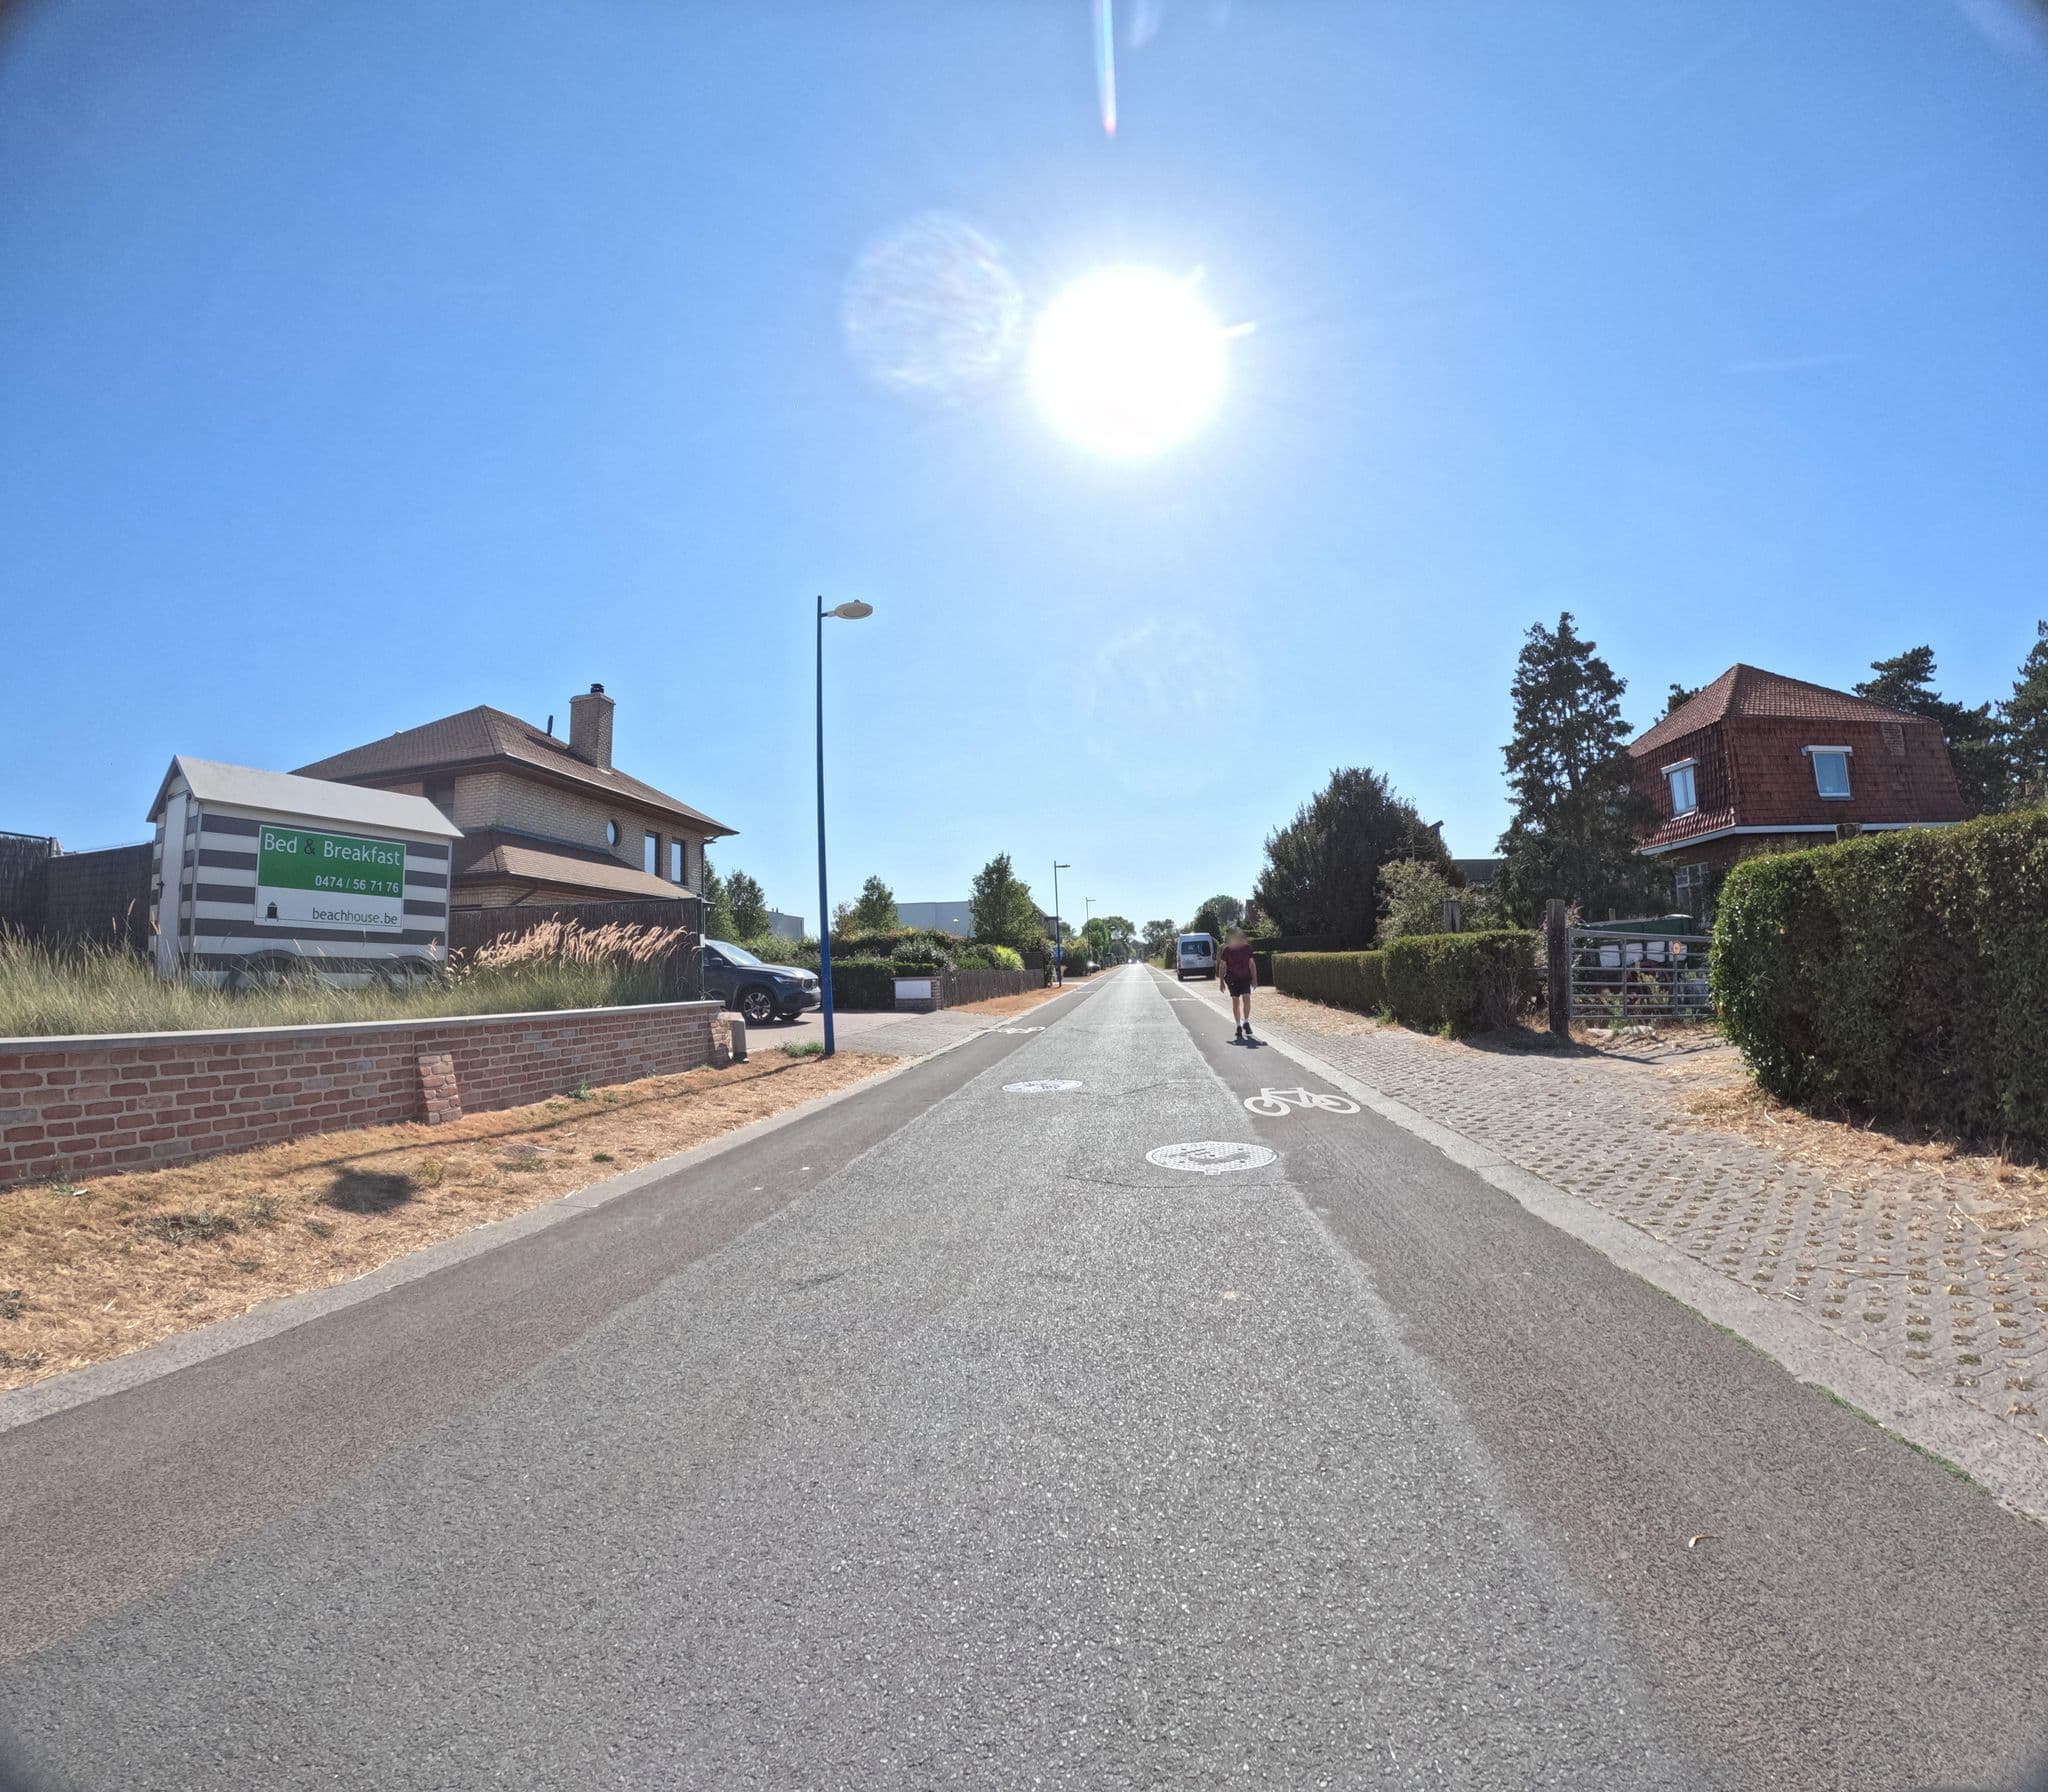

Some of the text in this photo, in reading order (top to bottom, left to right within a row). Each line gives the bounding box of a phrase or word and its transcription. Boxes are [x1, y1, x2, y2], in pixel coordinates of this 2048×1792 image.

[264, 833, 400, 866] Bed & Breakfast
[315, 875, 343, 888] 0474
[353, 878, 366, 891] 56
[371, 880, 382, 892] 71
[386, 881, 399, 893] 76
[312, 907, 398, 925] beachhouse.be
